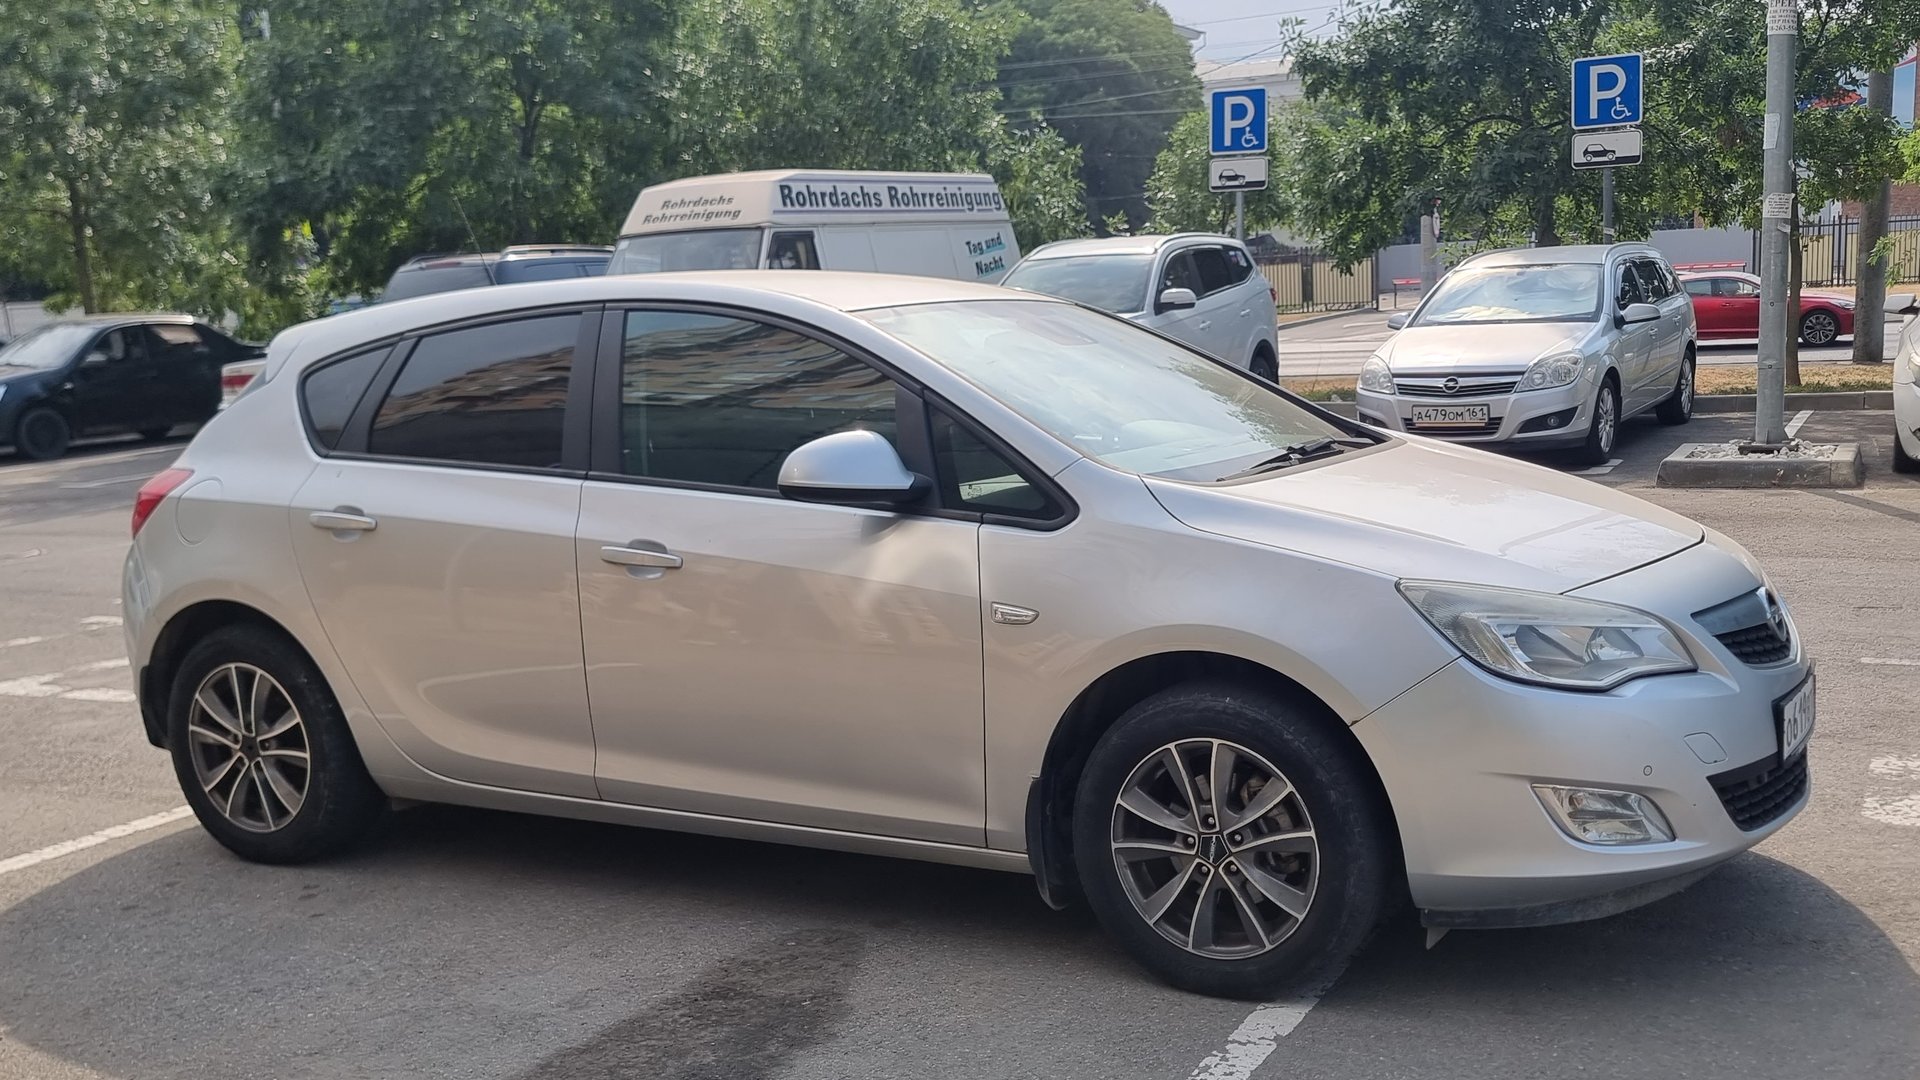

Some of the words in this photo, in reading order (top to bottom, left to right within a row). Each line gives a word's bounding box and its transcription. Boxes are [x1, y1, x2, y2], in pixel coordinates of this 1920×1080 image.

[1590, 64, 1626, 119] P
[1224, 96, 1255, 146] P
[661, 195, 734, 211] Rohrdachs
[780, 184, 883, 208] Rohrdachs
[887, 186, 1000, 211] Rohrreinigung
[642, 209, 742, 225] Rohrreinigung
[965, 240, 984, 256] Tag
[985, 233, 1003, 249] und
[975, 255, 1005, 276] Nacht
